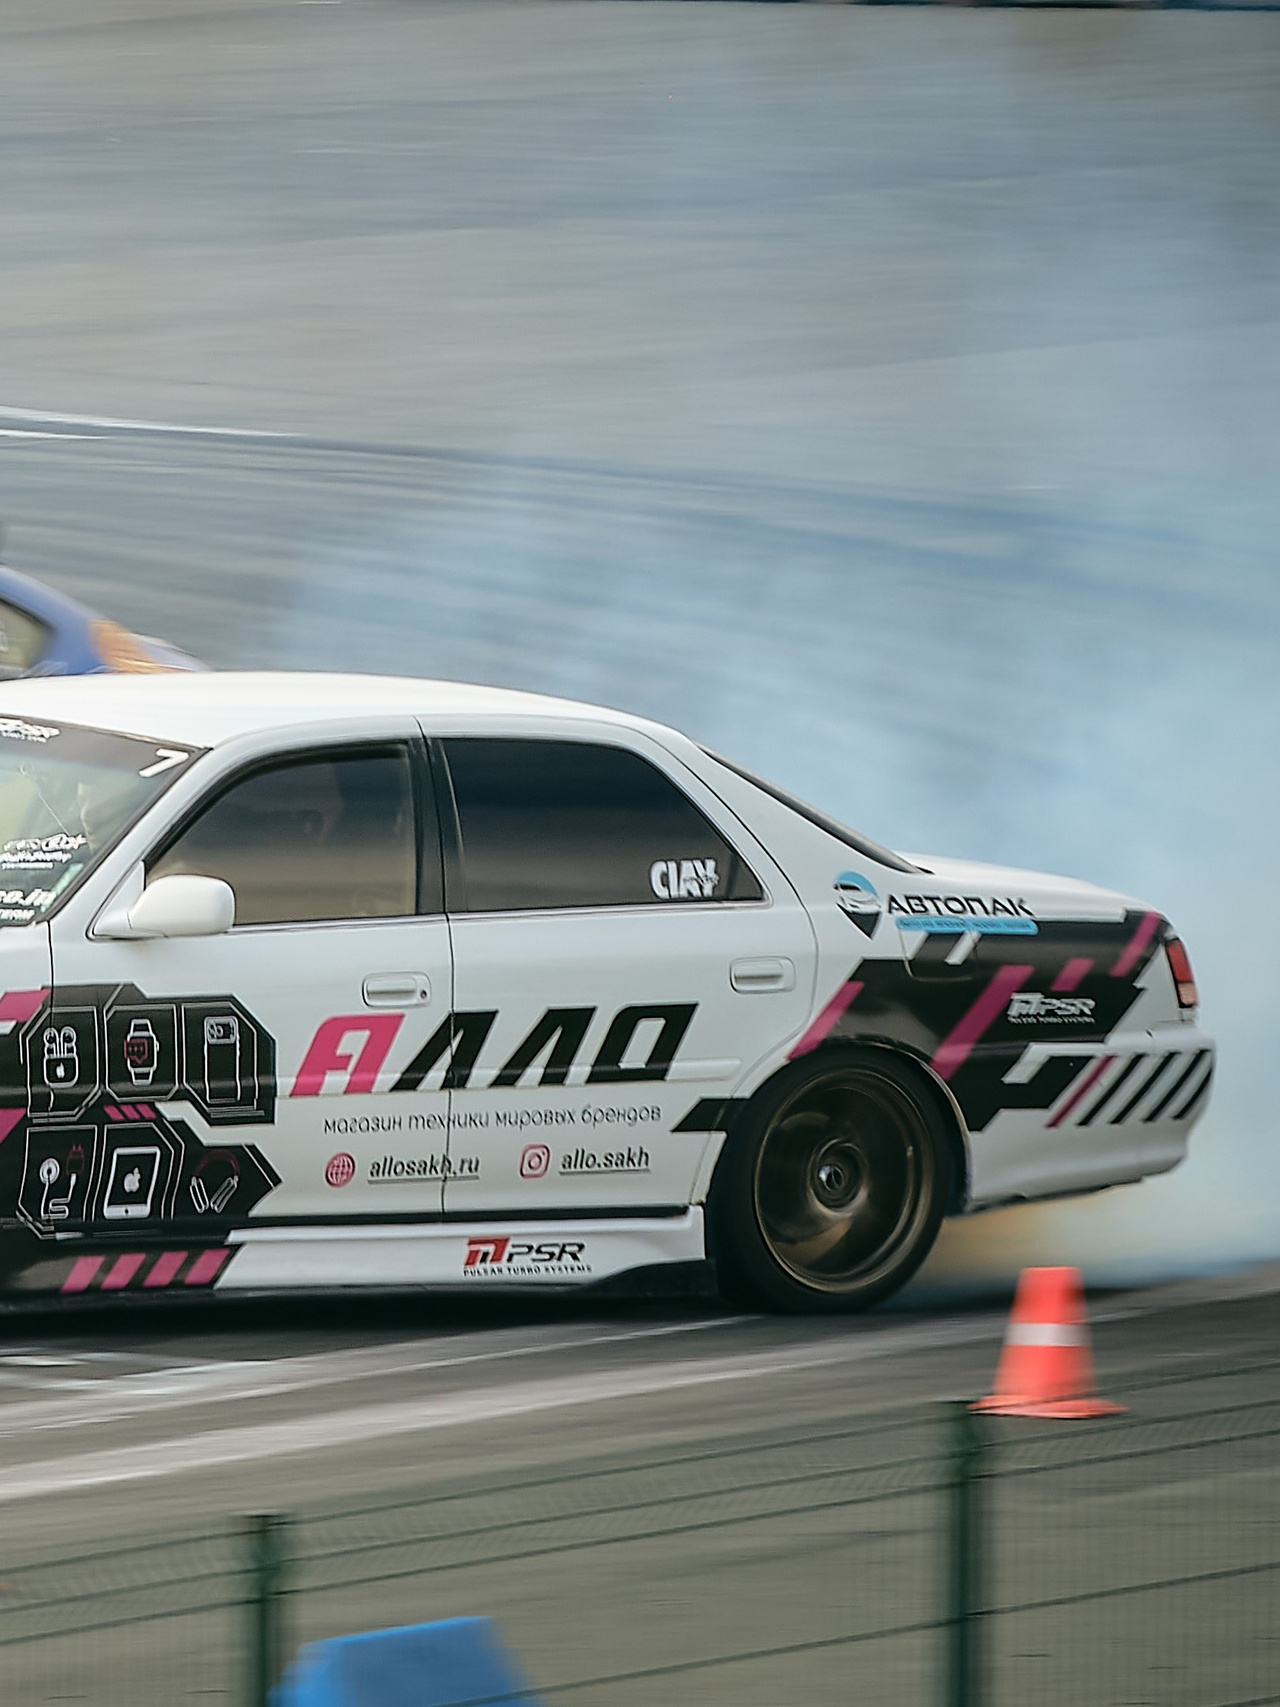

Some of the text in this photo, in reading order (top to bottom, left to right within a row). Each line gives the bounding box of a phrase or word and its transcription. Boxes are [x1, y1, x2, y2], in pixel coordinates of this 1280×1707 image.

[138, 748, 190, 778] 7
[887, 894, 1036, 917] АВТОПАК
[290, 1003, 699, 1098] АЛЛО
[323, 1104, 662, 1136] магазин техники мировых брендов
[369, 1147, 651, 1179] allosakh.ru allo.sakh
